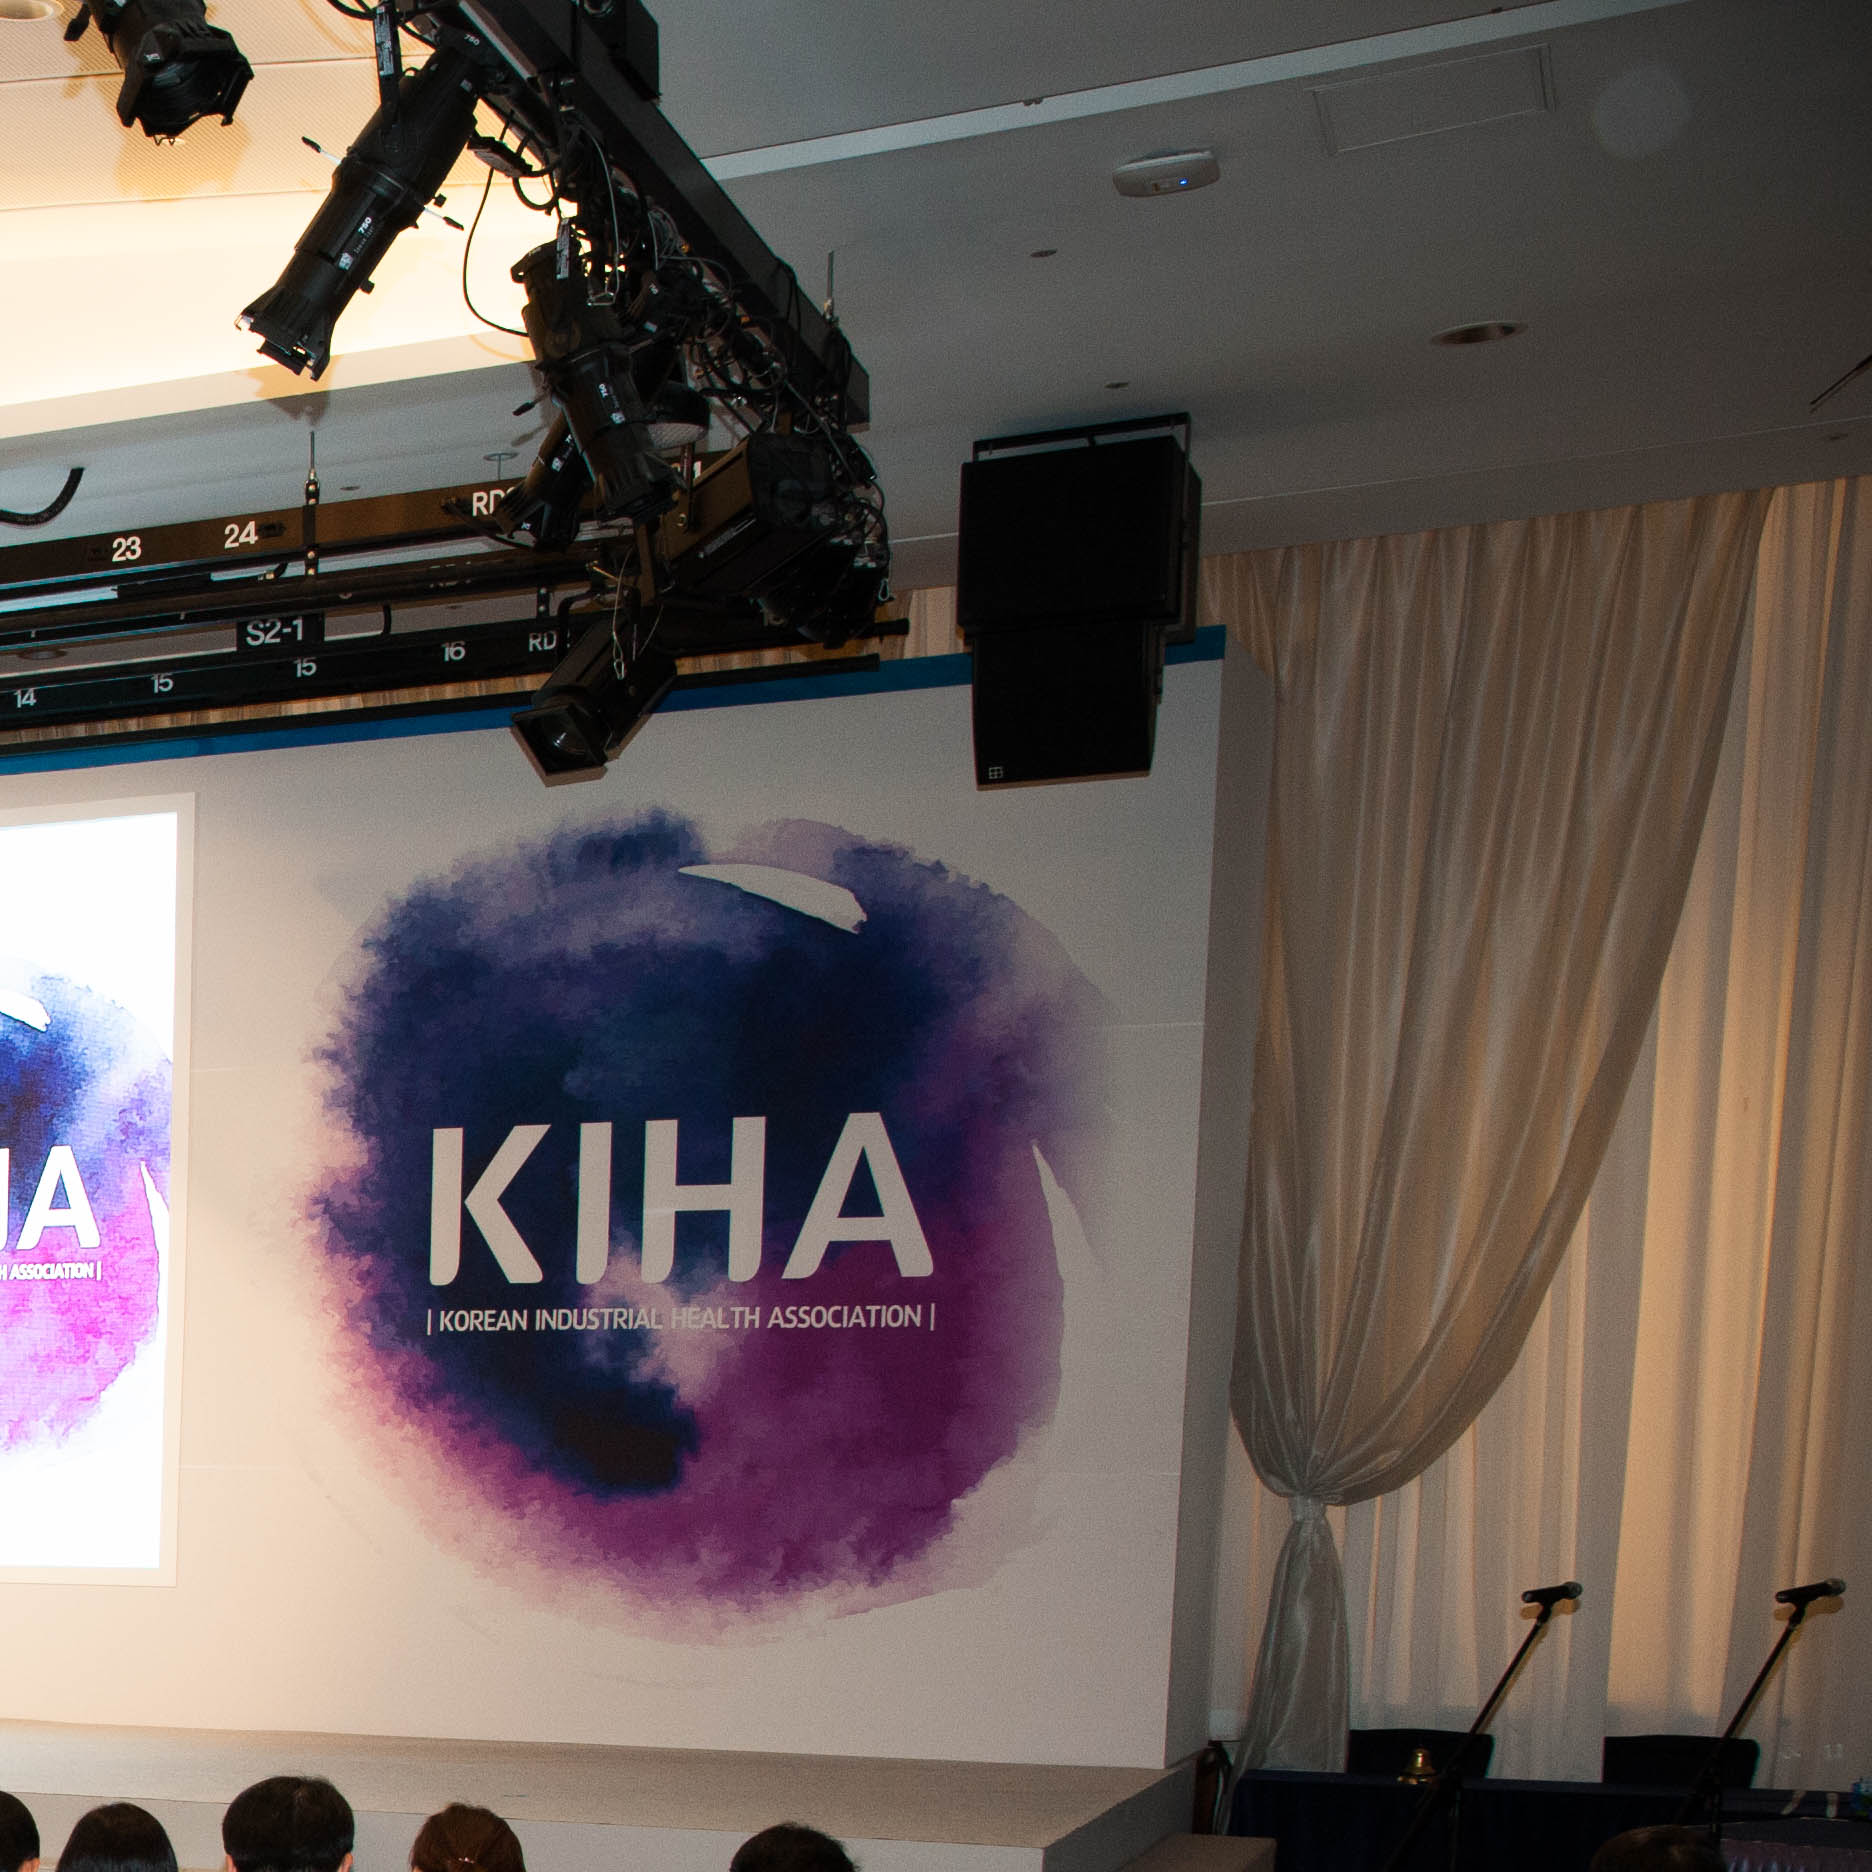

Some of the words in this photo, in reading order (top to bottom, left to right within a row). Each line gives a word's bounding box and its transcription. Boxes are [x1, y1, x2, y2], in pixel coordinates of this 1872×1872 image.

[471, 487, 519, 517] RD
[111, 535, 143, 562] 23
[223, 521, 259, 549] 24
[245, 615, 306, 646] S2-1
[294, 657, 317, 678] 15
[152, 673, 175, 693] 15
[14, 687, 37, 708] 14
[429, 1111, 935, 1287] KIHA
[9, 1261, 94, 1281] ASSOCIATION
[439, 1309, 528, 1333] KOREAN
[535, 1307, 664, 1332] INDUSTRIAL
[671, 1306, 761, 1330] HEALTH
[767, 1304, 922, 1329] ASSOCIATION
